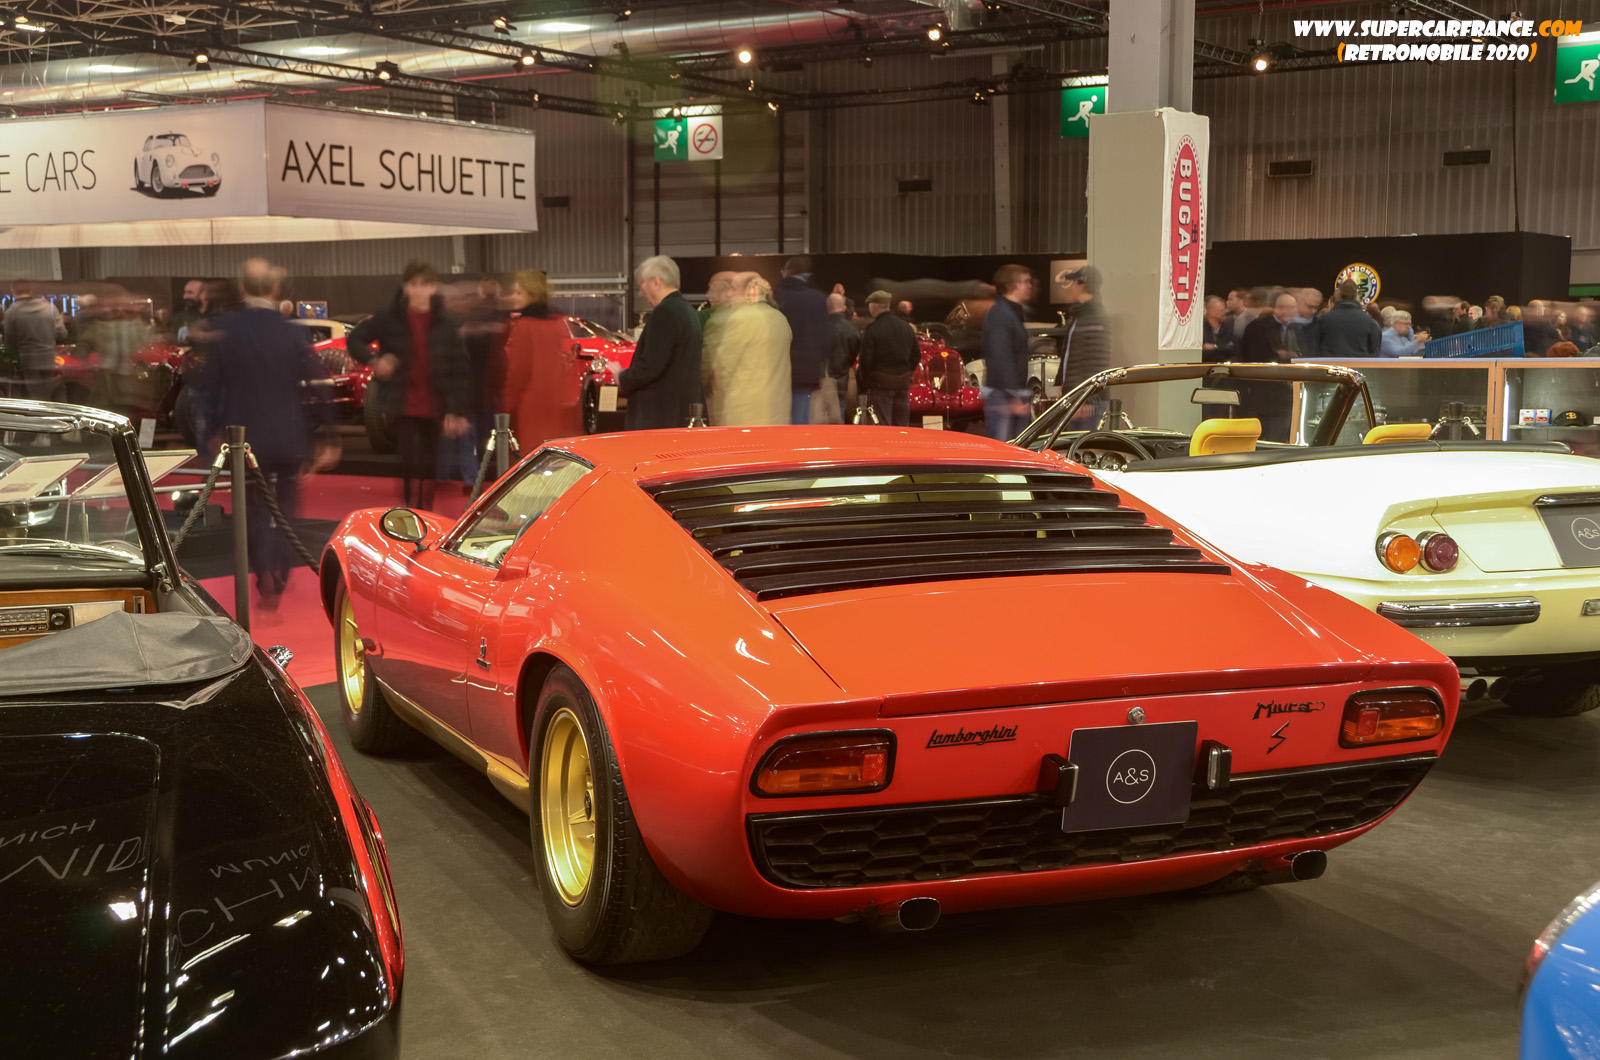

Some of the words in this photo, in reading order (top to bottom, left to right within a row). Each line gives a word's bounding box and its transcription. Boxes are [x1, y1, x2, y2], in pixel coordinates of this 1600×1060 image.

[25, 149, 97, 192] CARS
[281, 139, 365, 187] AXEL
[379, 149, 526, 200] SCHUETTE
[1176, 158, 1192, 301] BUGATTI
[1578, 527, 1600, 539] A&S
[1251, 700, 1325, 720] Miura
[1266, 720, 1290, 755] S
[1113, 767, 1149, 785] A&S
